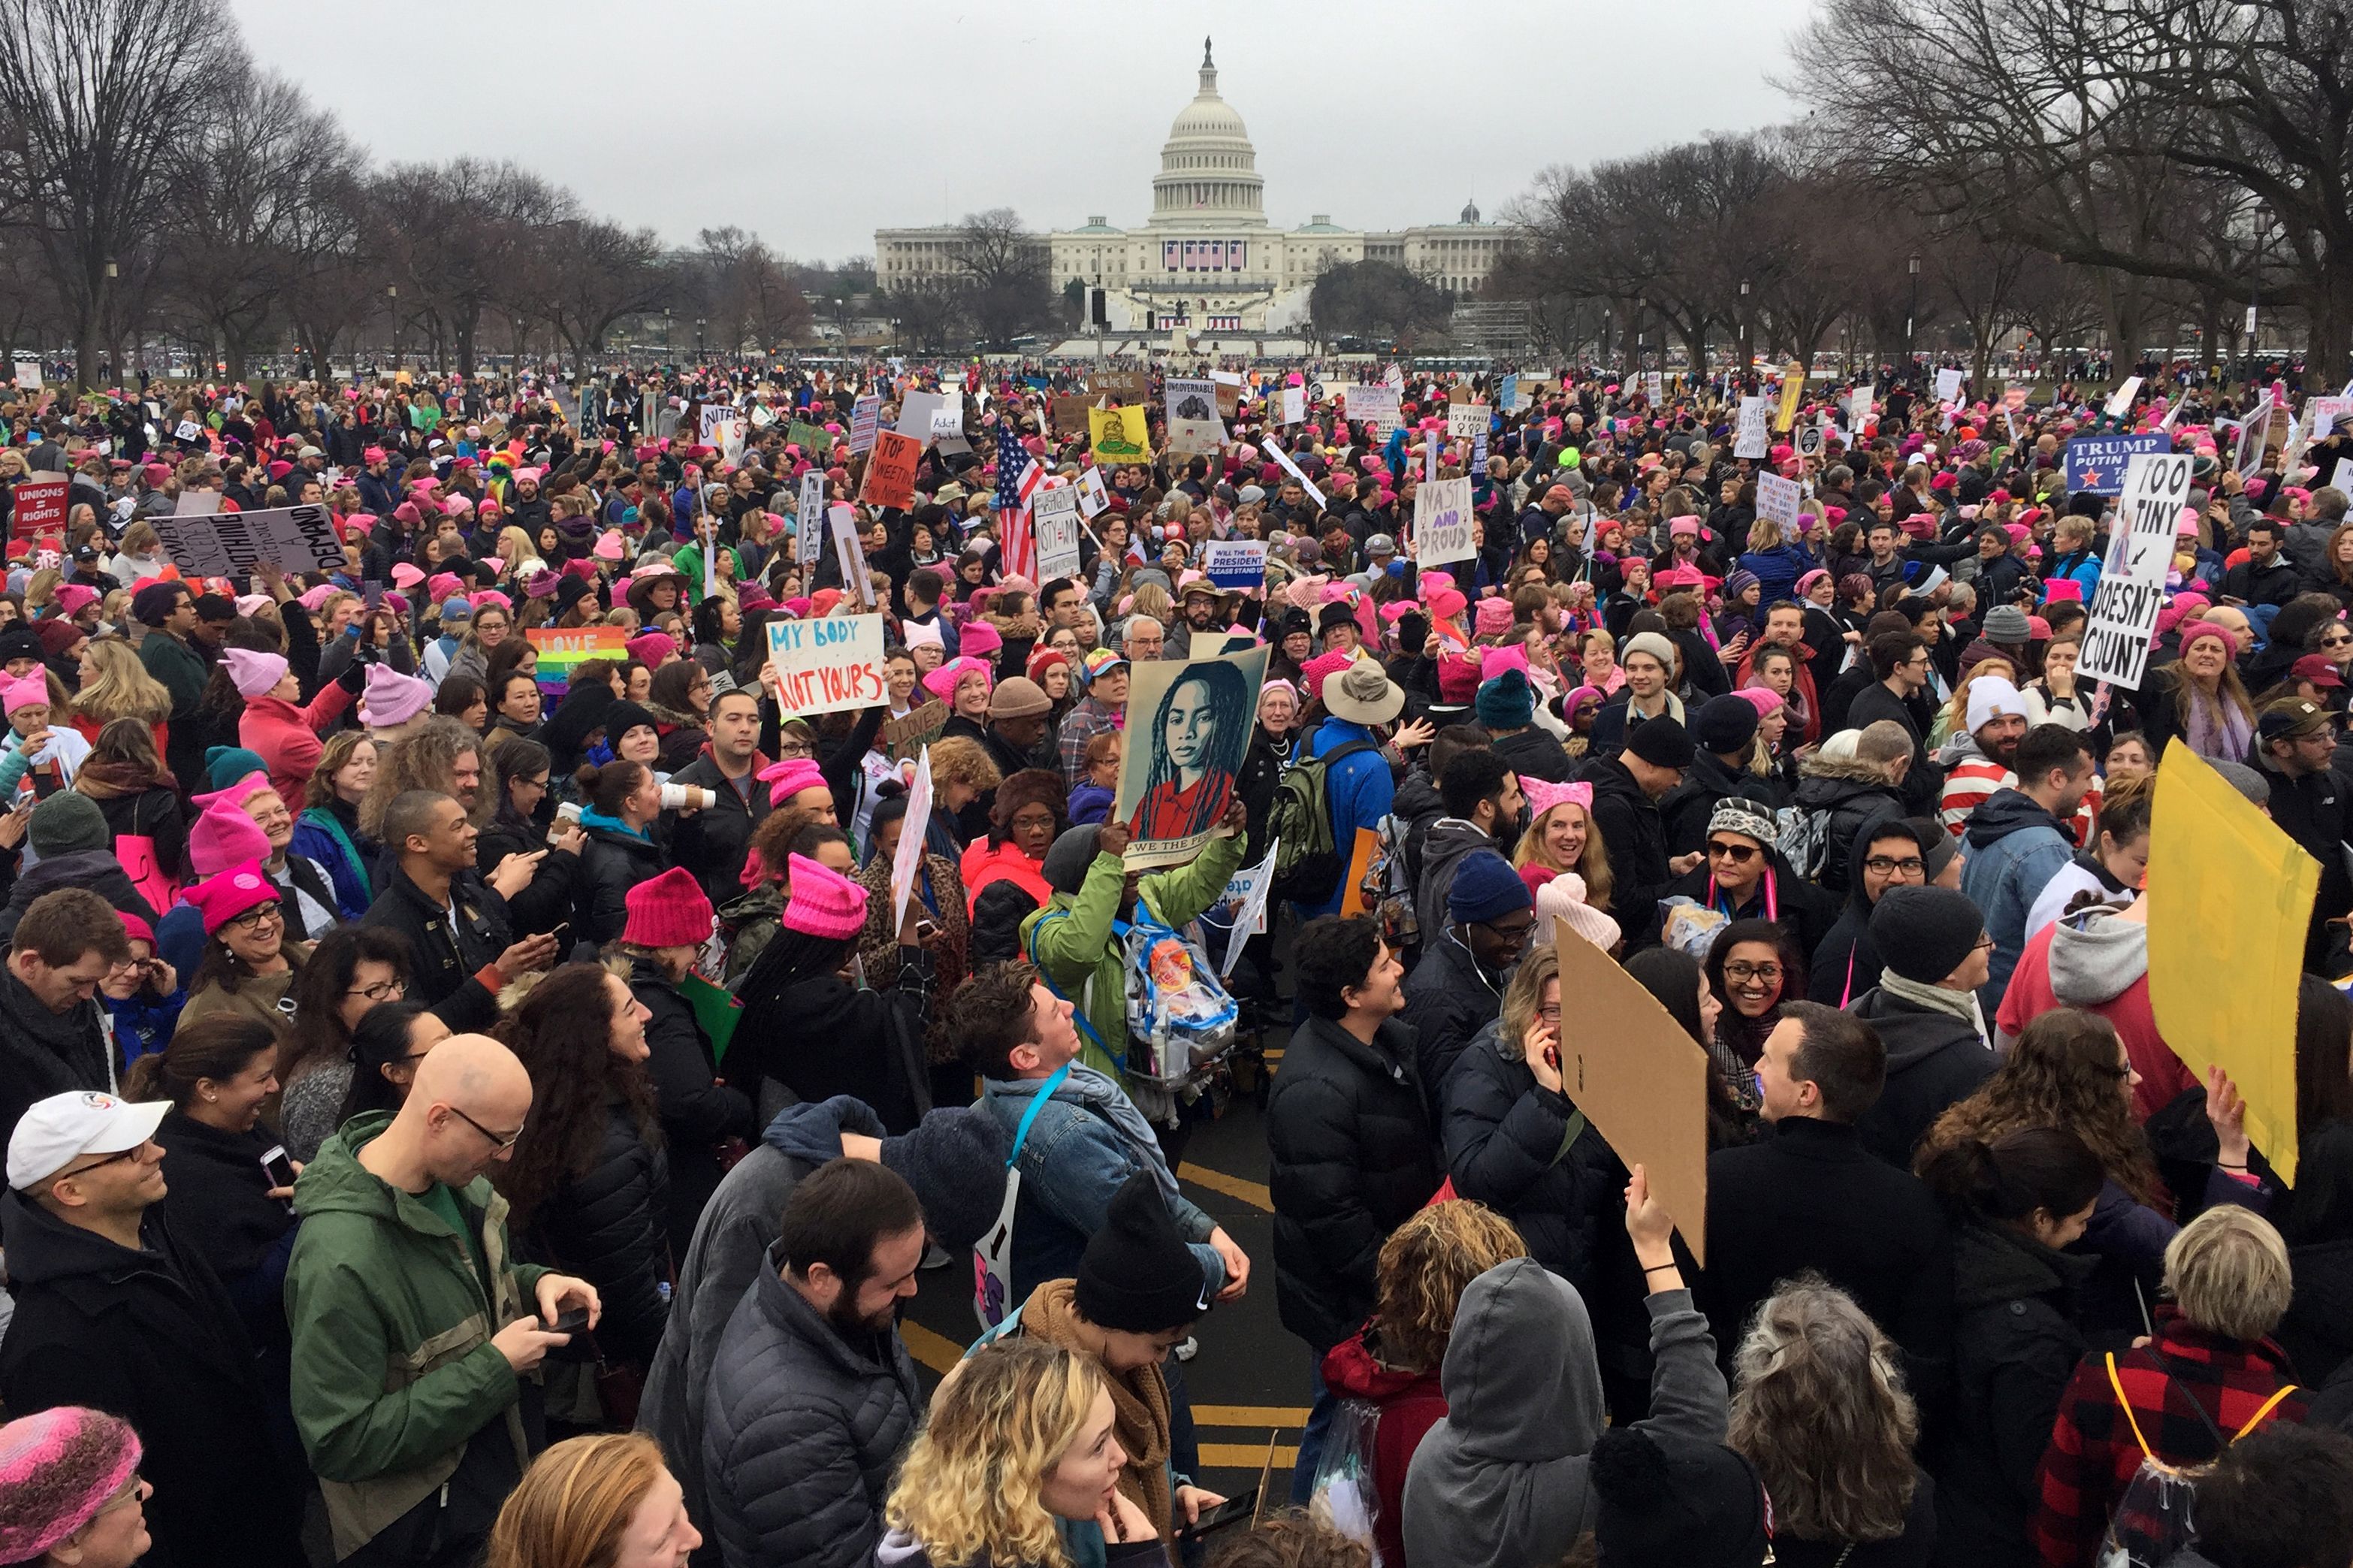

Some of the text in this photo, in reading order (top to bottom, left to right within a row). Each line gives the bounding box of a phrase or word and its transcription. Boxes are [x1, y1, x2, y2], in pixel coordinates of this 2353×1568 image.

[1167, 382, 1215, 394] UNGOVERNABLE
[1463, 415, 1488, 423] FEMALE
[2073, 439, 2158, 457] TRUMP
[2075, 455, 2123, 467] PUTIN
[2138, 458, 2187, 497] TOO
[19, 487, 65, 502] UNIONS
[1424, 480, 1468, 515] NASTY
[22, 507, 60, 522] RIGHTS
[1433, 509, 1459, 529] AND
[2134, 498, 2182, 536] TINY
[150, 518, 201, 578] POWER
[180, 521, 228, 577] CONCEDES
[207, 515, 260, 576] NOTHING
[279, 536, 305, 545] A
[290, 506, 348, 569] DEMAND
[1419, 527, 1467, 560] PROUD
[1207, 567, 1234, 576] PLEASE
[1234, 566, 1256, 575] STAND
[1213, 557, 1263, 566] PRESIDENT
[2091, 579, 2161, 630] DOESN'T
[540, 633, 599, 654] LOVE
[771, 620, 858, 652] MY BODY
[2080, 626, 2148, 682] COUNT
[775, 663, 883, 711] NOT YOURS
[898, 709, 935, 744] LOVE
[1135, 842, 1157, 852] WE
[1161, 840, 1189, 850] THE
